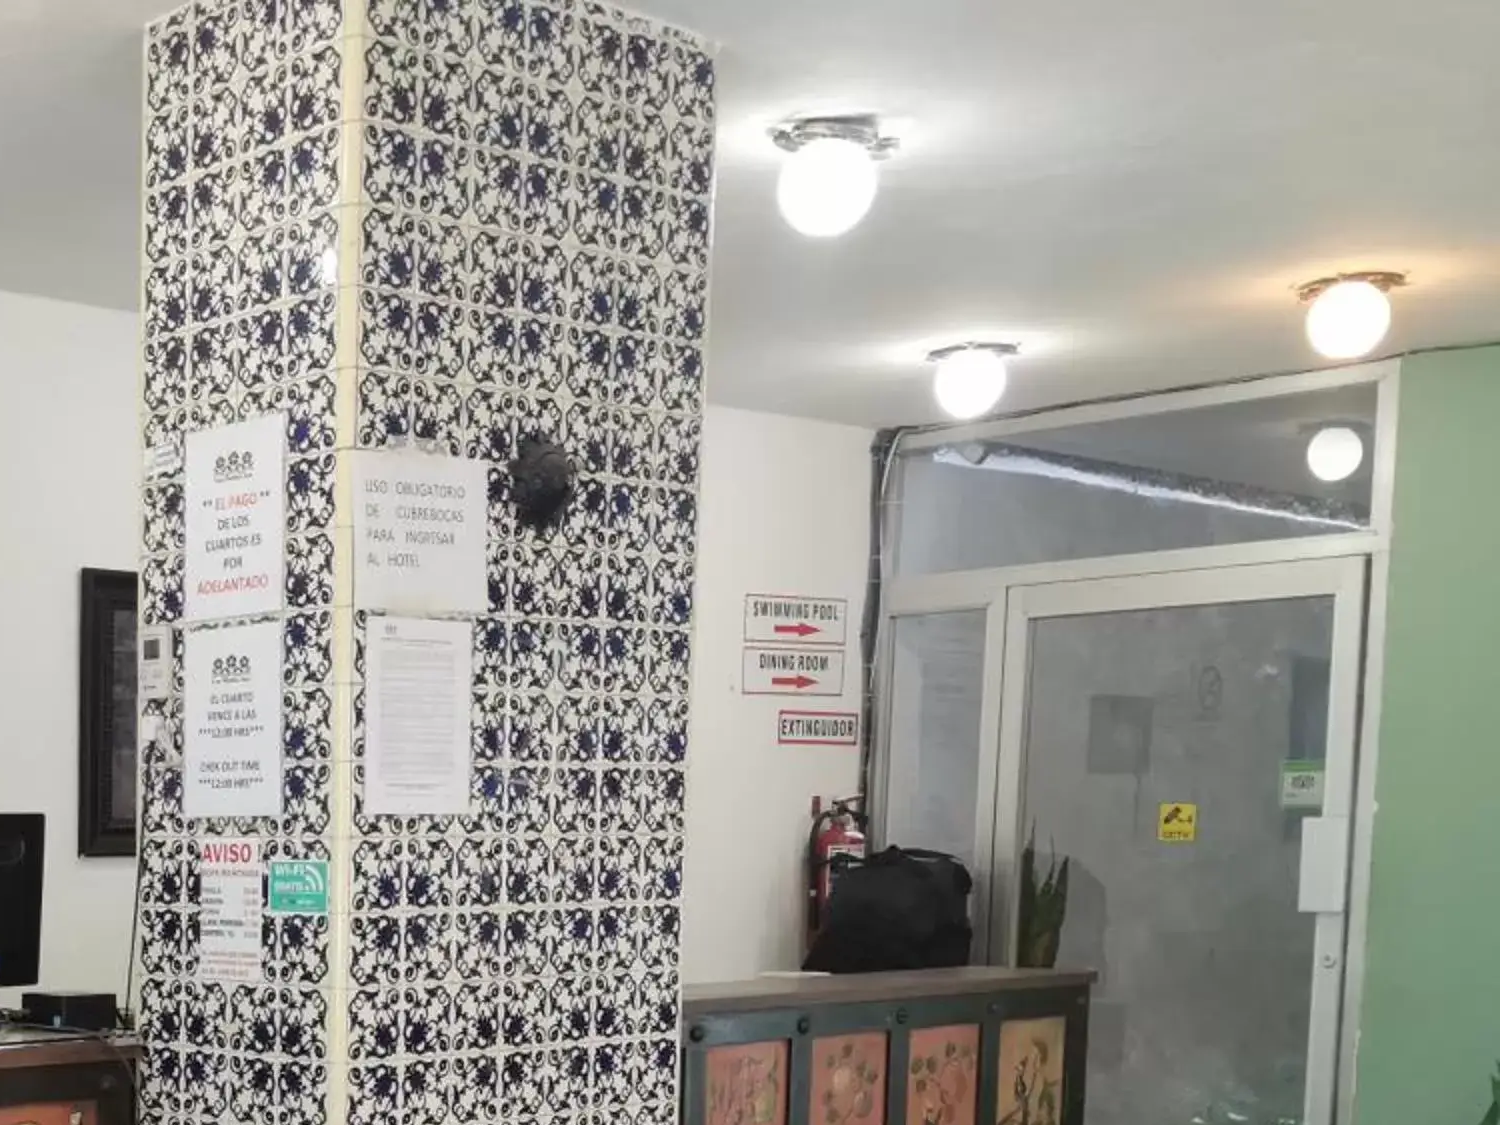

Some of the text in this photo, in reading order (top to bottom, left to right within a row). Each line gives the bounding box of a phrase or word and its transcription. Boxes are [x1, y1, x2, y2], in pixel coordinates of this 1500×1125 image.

[365, 480, 466, 499] USO OBLIGATORIO
[365, 503, 465, 523] DE CUBREBOCAS
[231, 515, 251, 530] LOS
[205, 537, 249, 553] CUARTOS
[366, 528, 456, 546] PARA INGRESAR
[223, 556, 243, 569] POR
[367, 552, 420, 569] AL HOTEL
[197, 573, 269, 595] ADELANTADO
[753, 600, 839, 621] SWIMMING POOL
[759, 653, 829, 671] DINING ROOM
[781, 719, 854, 737] EXTINGUIDOR
[202, 843, 252, 864] AVISO
